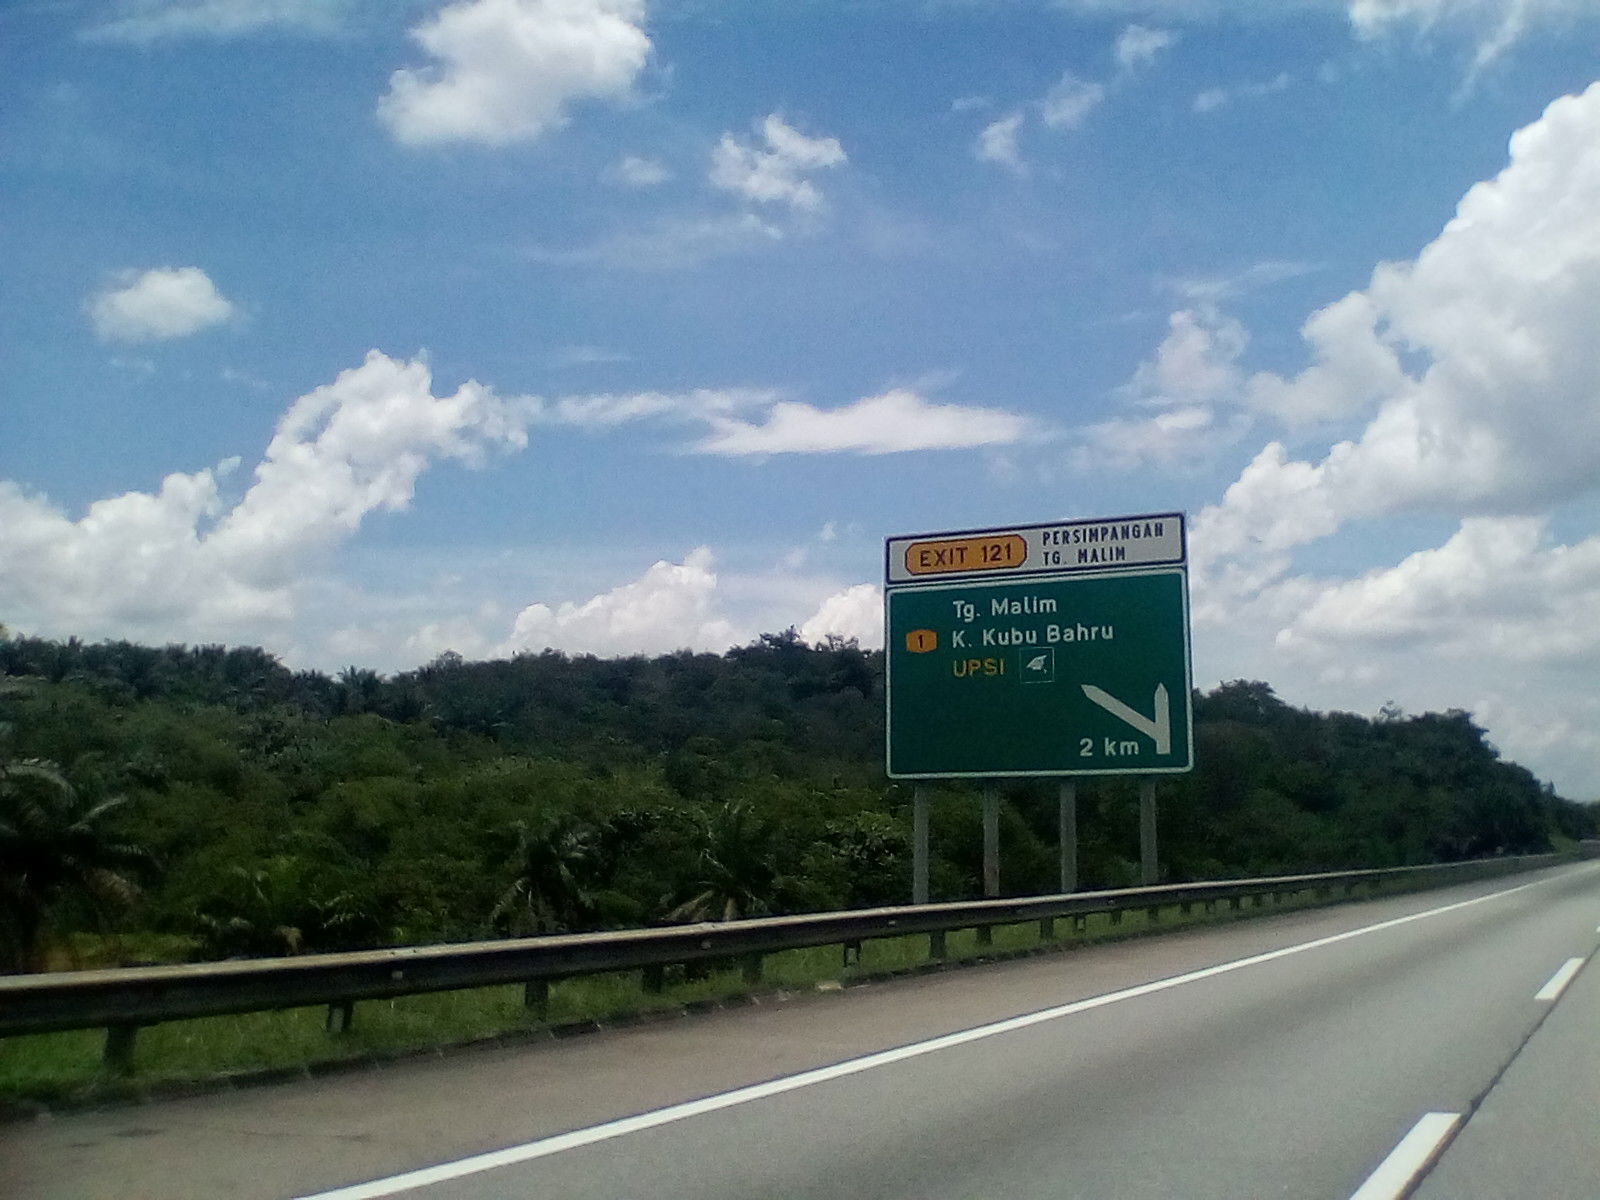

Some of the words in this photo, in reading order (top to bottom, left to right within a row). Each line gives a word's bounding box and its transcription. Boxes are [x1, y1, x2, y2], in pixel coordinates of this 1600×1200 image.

[1042, 522, 1164, 546] PERSIMPANGAN
[919, 546, 969, 568] EXIT
[982, 543, 1012, 564] 121
[1042, 551, 1069, 567] TG.
[1077, 547, 1126, 564] MALIM
[952, 600, 981, 623] Tg.
[991, 596, 1057, 616] Malim
[917, 634, 924, 649] 1
[952, 632, 973, 649] K.
[983, 627, 1038, 646] Kubu
[1046, 623, 1114, 643] Bahru
[953, 658, 1004, 677] UPSI
[1079, 738, 1093, 757] 2
[1104, 737, 1140, 757] km
